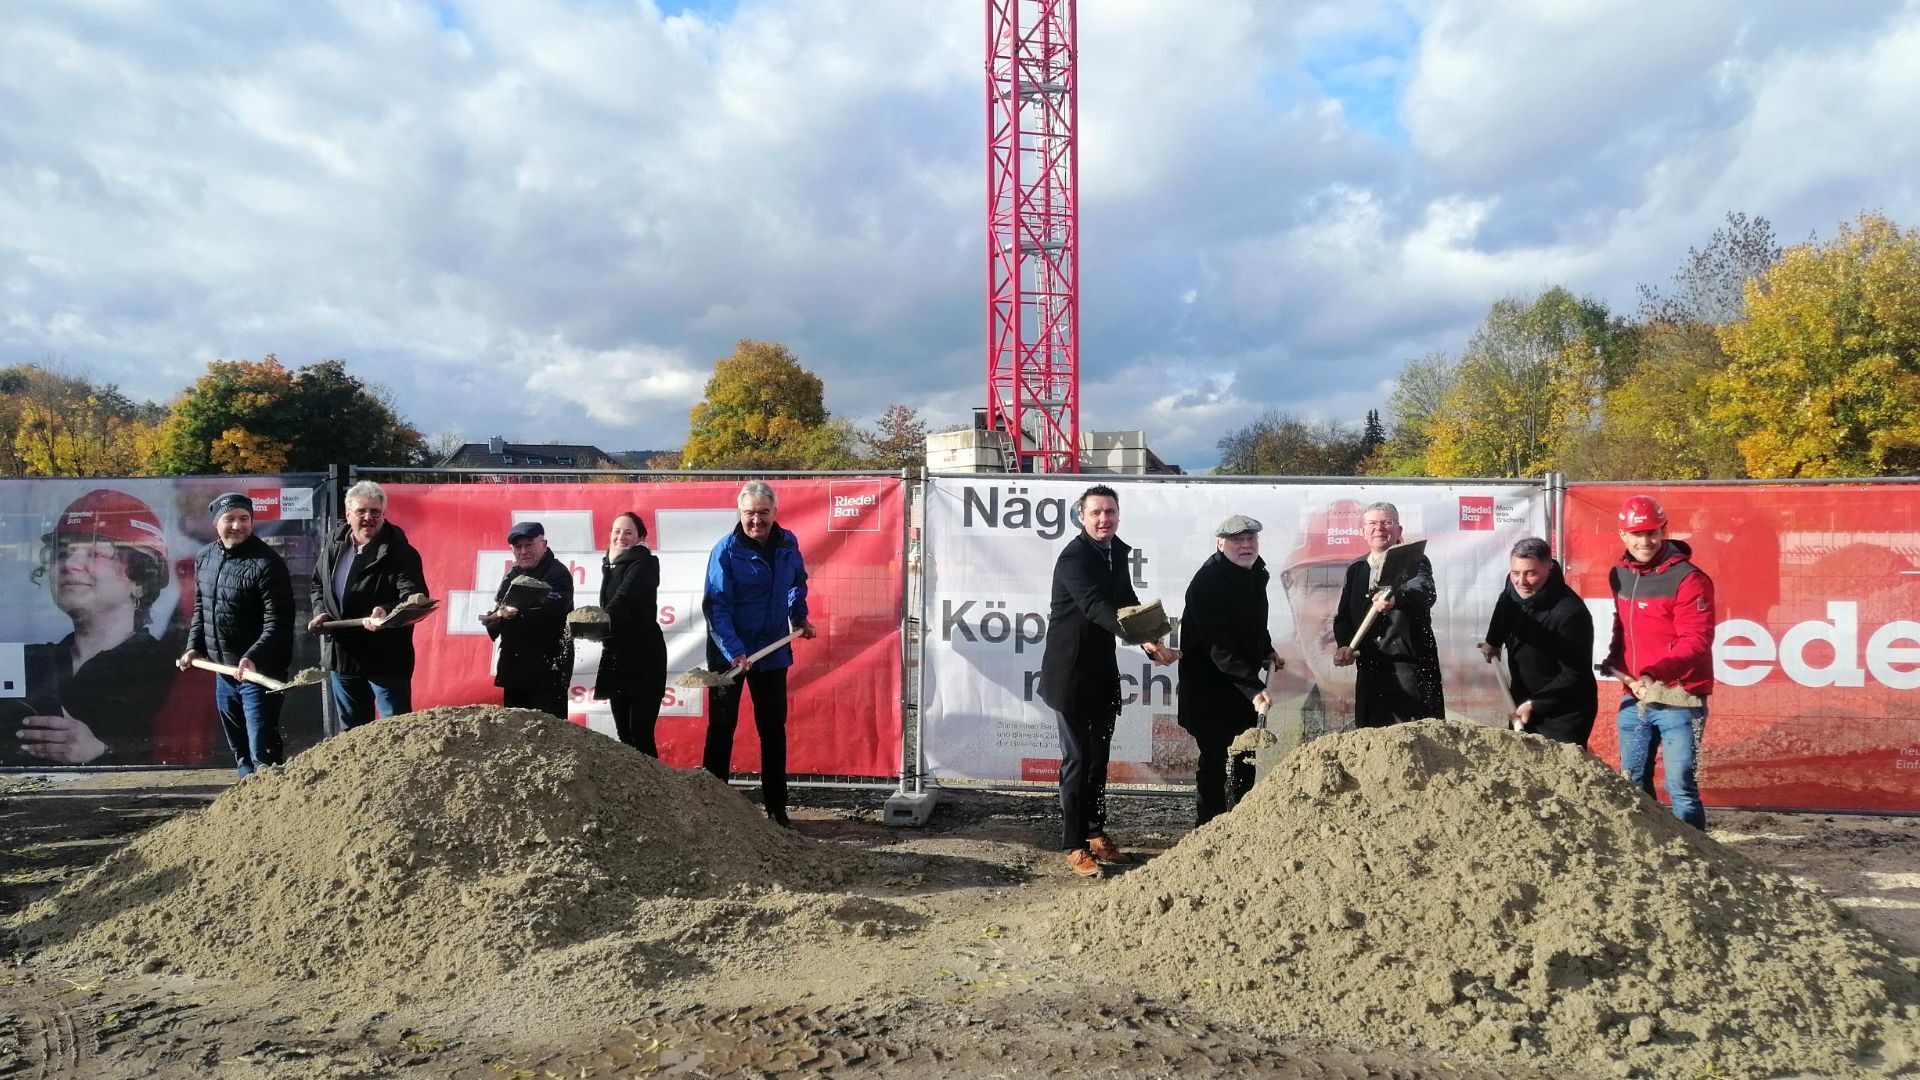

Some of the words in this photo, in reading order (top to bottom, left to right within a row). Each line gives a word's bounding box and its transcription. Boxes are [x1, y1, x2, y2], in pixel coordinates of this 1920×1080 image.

[834, 494, 876, 507] Riedel
[833, 507, 859, 517] Bau
[963, 486, 1083, 540] Näg
[1461, 505, 1492, 514] Riedel
[1461, 513, 1480, 521] Bau
[1327, 527, 1364, 537] Riedel
[1327, 536, 1350, 544] Bau
[1896, 759, 1920, 769] Einf
